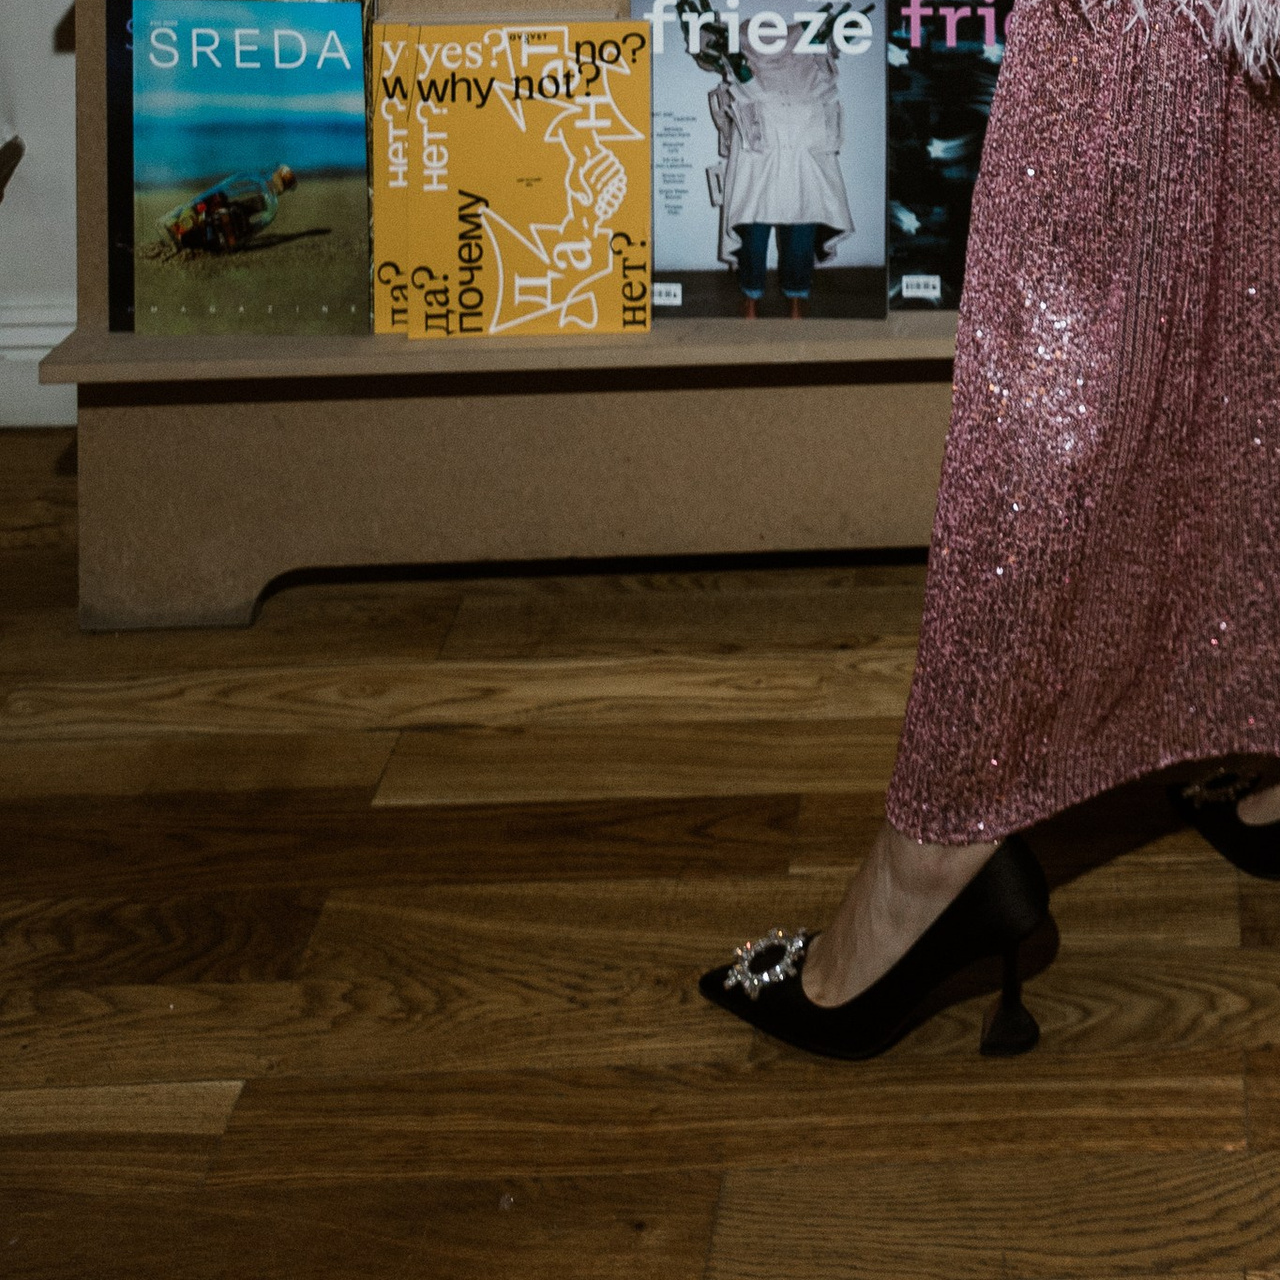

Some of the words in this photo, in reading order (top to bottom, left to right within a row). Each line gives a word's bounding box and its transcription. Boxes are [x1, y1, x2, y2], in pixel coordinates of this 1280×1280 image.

[149, 27, 352, 71] SREDA
[416, 28, 505, 81] yes?
[575, 32, 647, 66] no?
[416, 72, 496, 109] why
[512, 61, 601, 102] not?
[457, 189, 490, 334] почему
[609, 231, 648, 329] нет?
